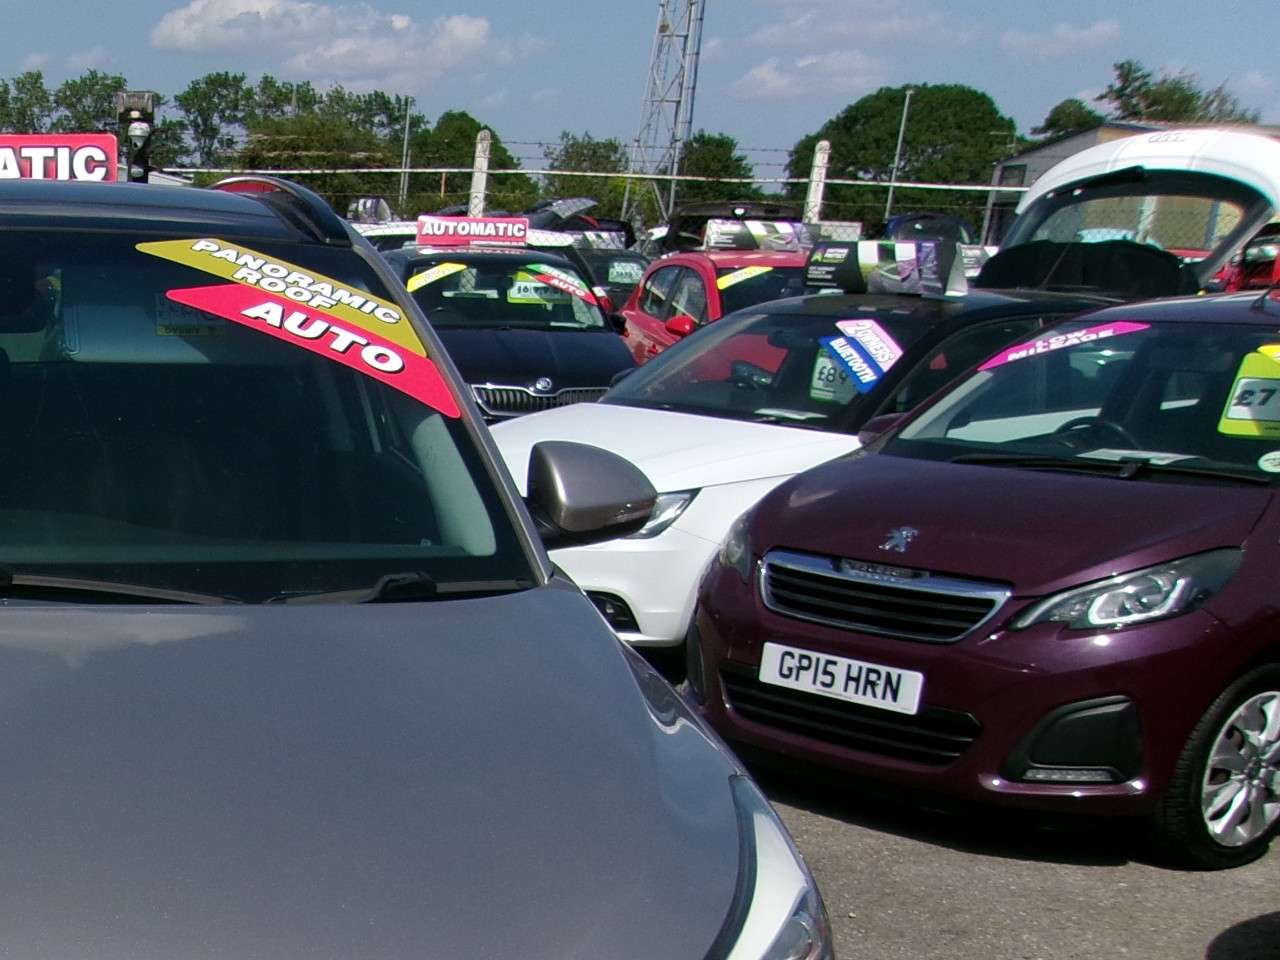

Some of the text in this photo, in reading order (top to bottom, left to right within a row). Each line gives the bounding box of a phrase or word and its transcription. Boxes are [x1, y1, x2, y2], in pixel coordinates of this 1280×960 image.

[421, 221, 526, 238] AUTOMATIC
[192, 239, 402, 324] PANORAMIC
[232, 268, 338, 310] ROOF
[549, 278, 586, 297] AUTO
[240, 301, 405, 373] AUTO
[1008, 328, 1114, 362] MILEAGE
[1035, 329, 1088, 348] LOW
[829, 337, 877, 383] BLUETOOTH
[778, 651, 902, 703] GP15 HRN
